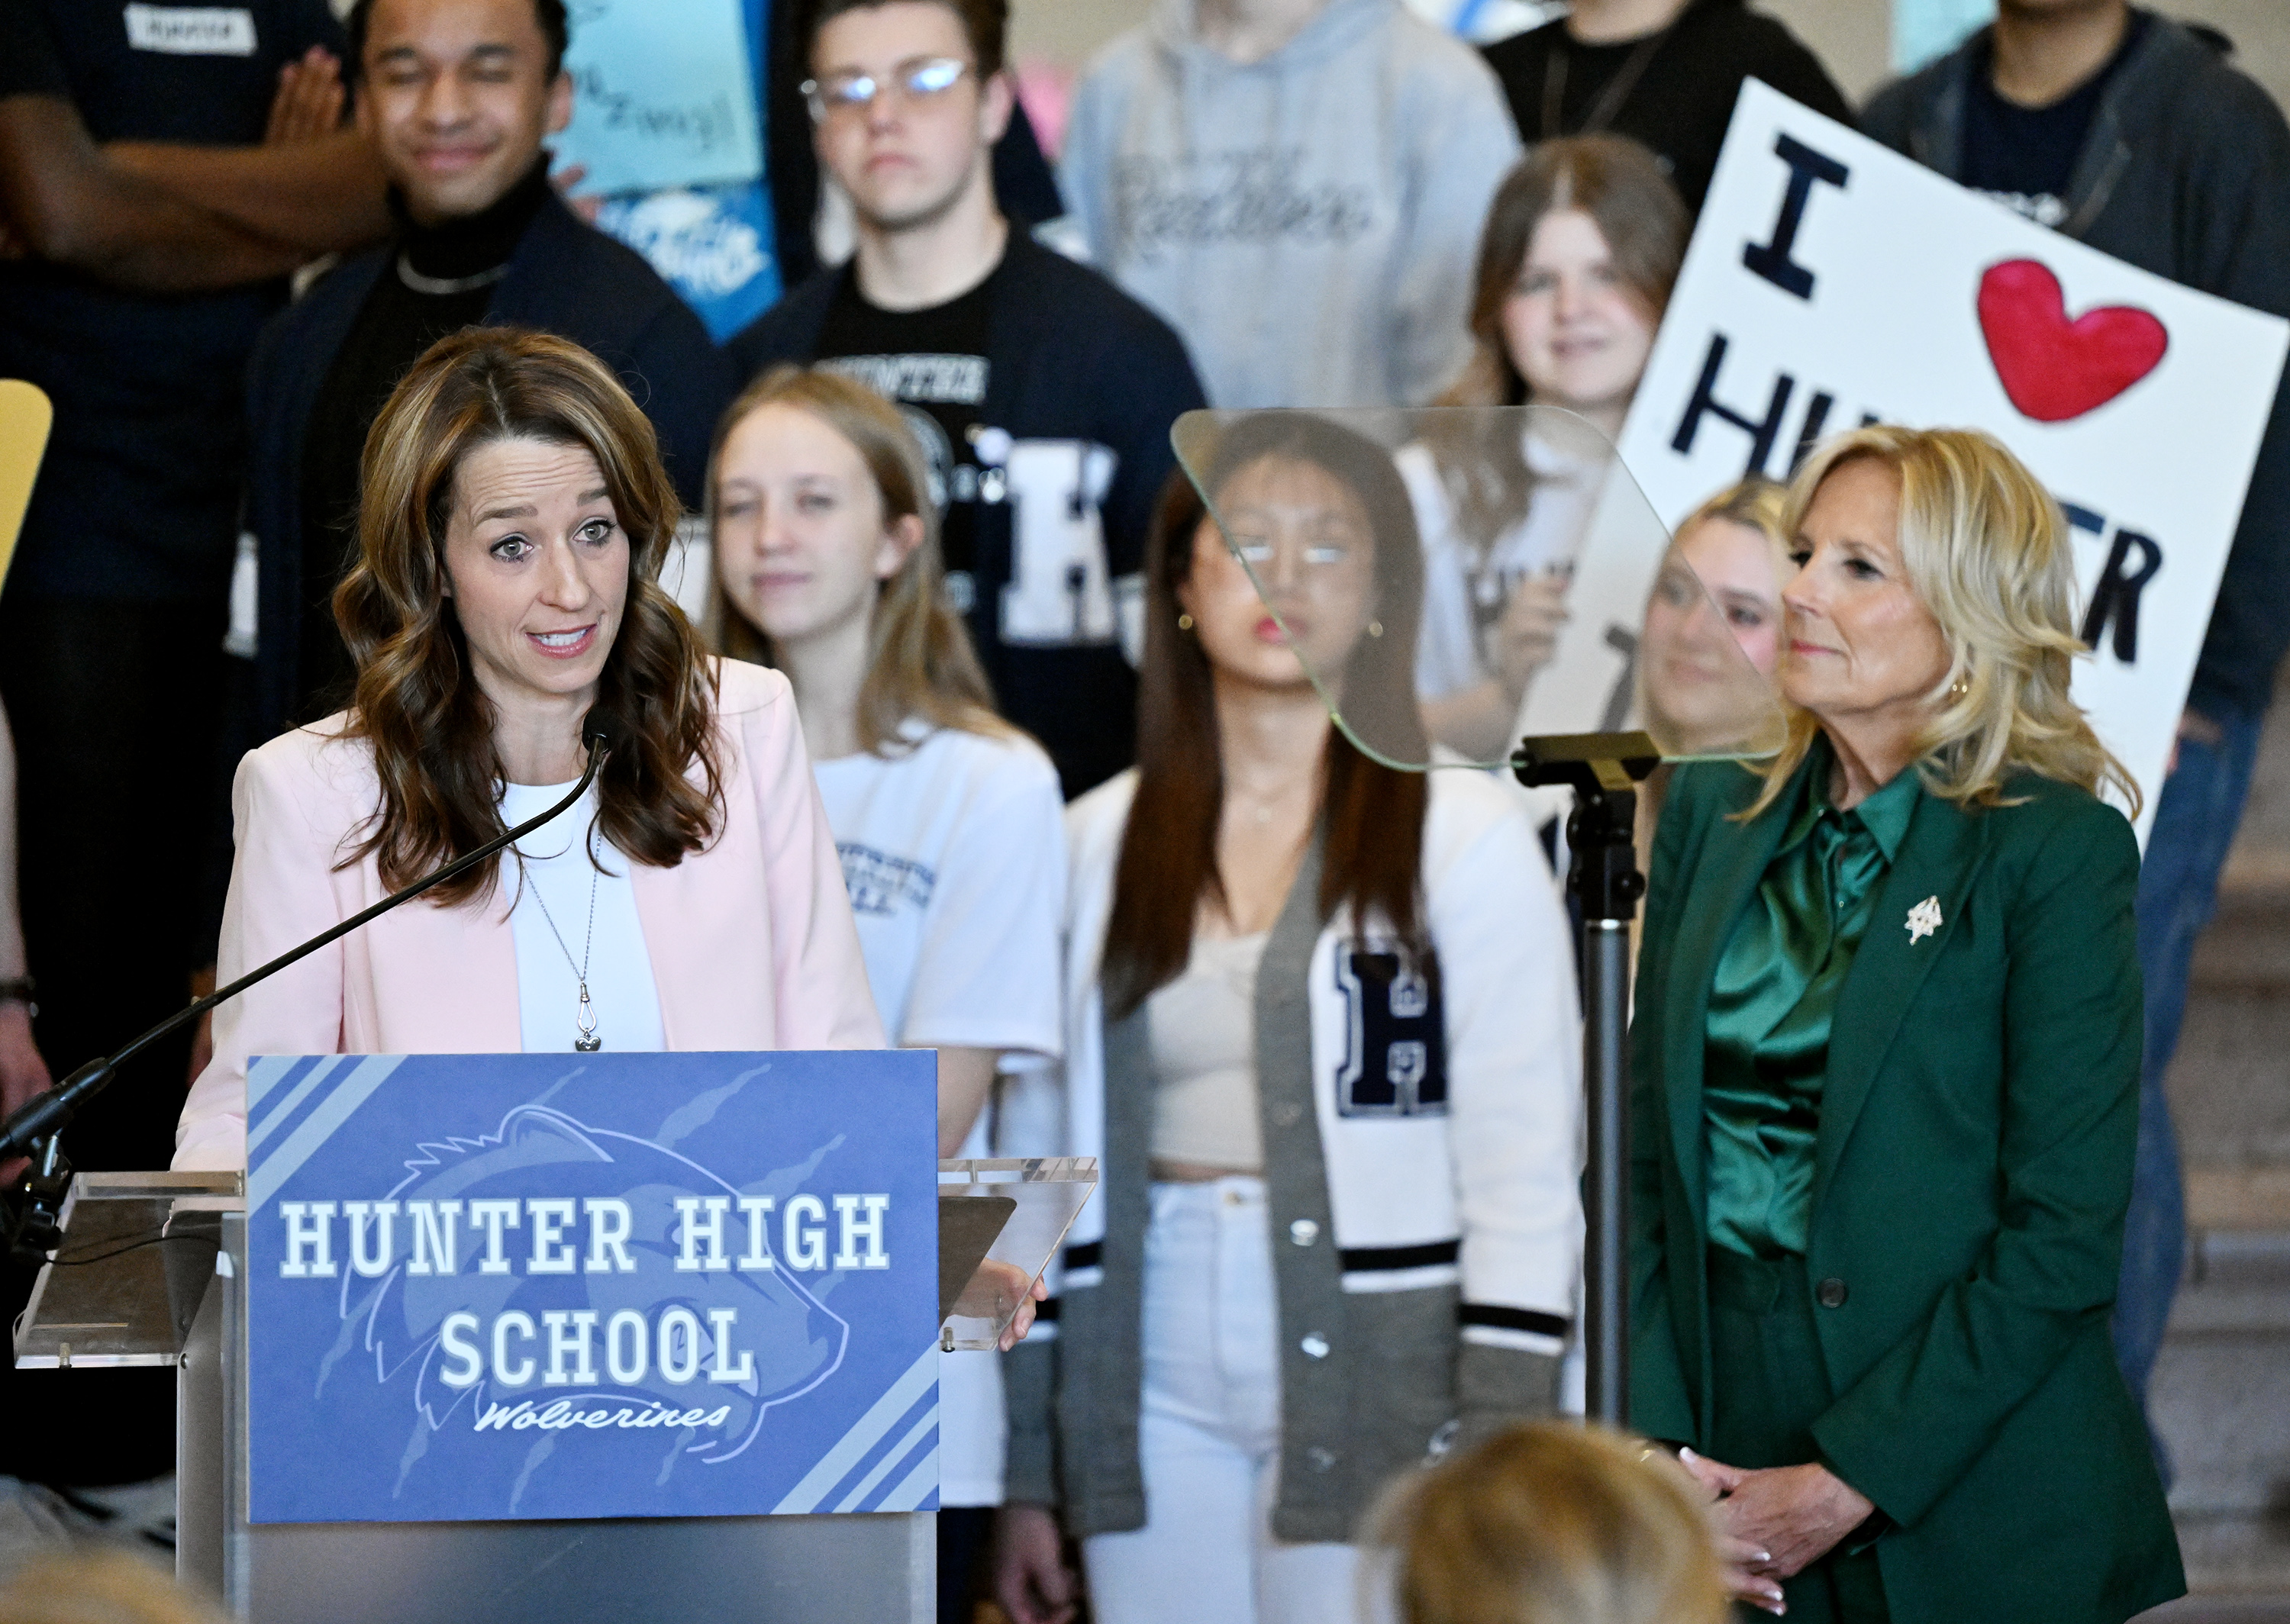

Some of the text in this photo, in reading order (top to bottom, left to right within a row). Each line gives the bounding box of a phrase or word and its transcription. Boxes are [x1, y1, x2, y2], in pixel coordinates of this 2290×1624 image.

[1740, 134, 1850, 300] I
[1001, 440, 1118, 647] H
[1336, 940, 1449, 1119] H
[279, 1194, 892, 1278] HUNTER HIGH
[439, 1309, 753, 1387] SCHOOL
[474, 1400, 731, 1432] Wolverines
